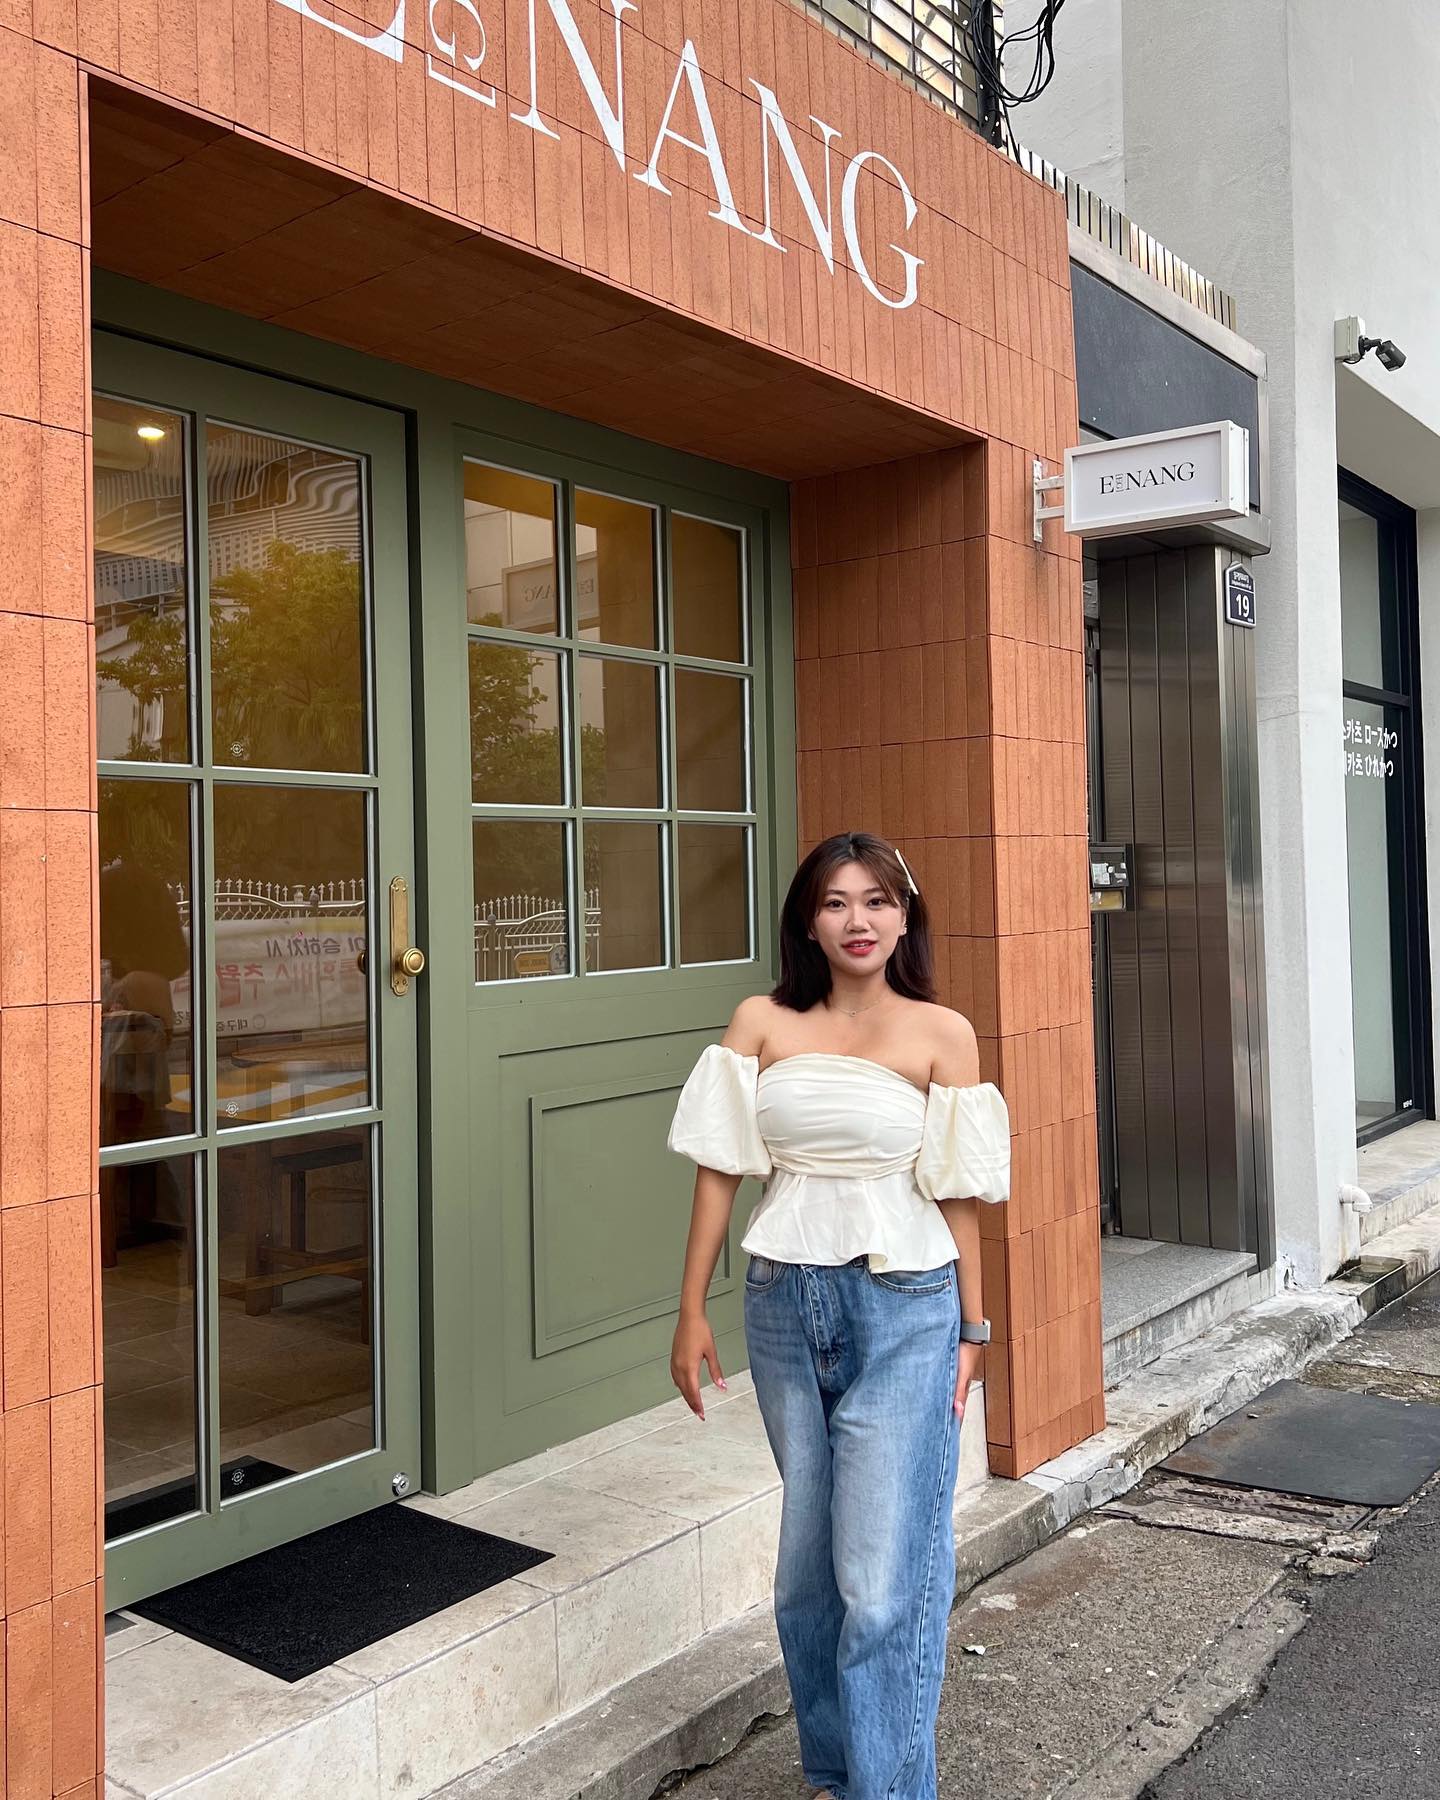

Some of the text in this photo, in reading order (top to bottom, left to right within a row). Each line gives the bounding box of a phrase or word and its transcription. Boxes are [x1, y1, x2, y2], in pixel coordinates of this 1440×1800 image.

[275, 0, 925, 309] NANG
[1235, 593, 1250, 618] 19
[1364, 724, 1398, 750] ロースかつ
[1364, 754, 1394, 778] ひれかつ
